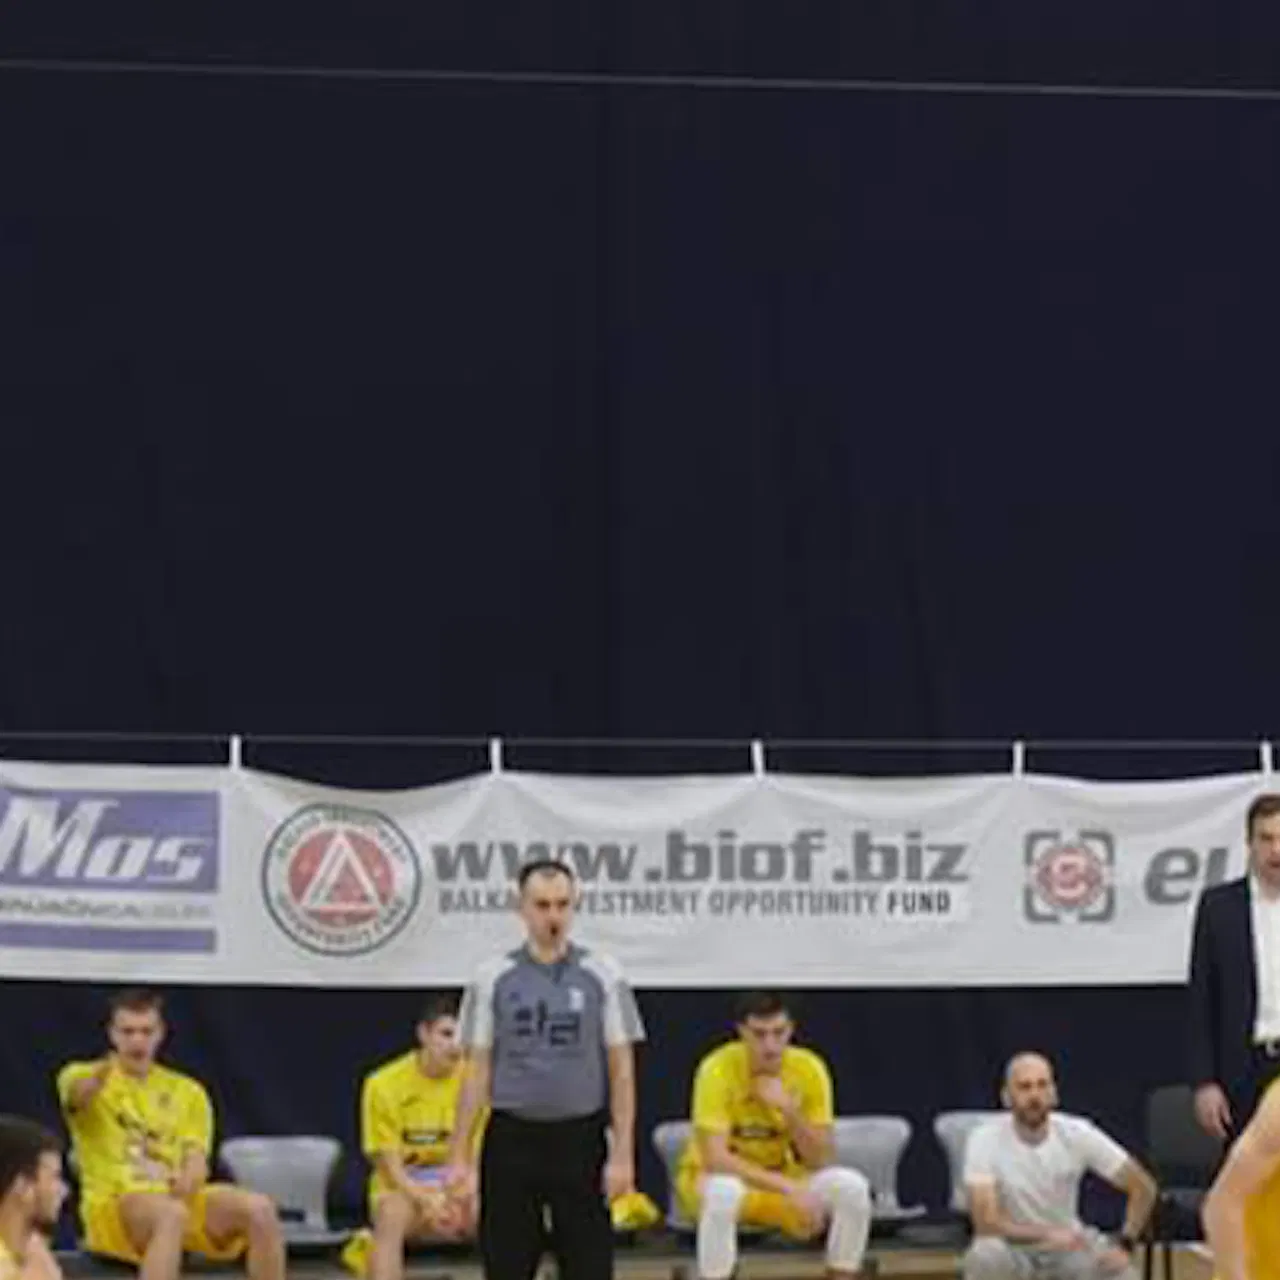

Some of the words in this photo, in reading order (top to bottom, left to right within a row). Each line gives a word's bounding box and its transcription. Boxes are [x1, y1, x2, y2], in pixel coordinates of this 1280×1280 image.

[438, 887, 519, 914] BALKA
[574, 887, 699, 914] VESTMENT
[709, 888, 877, 916] OPPORTUNITY
[887, 888, 951, 916] FUND
